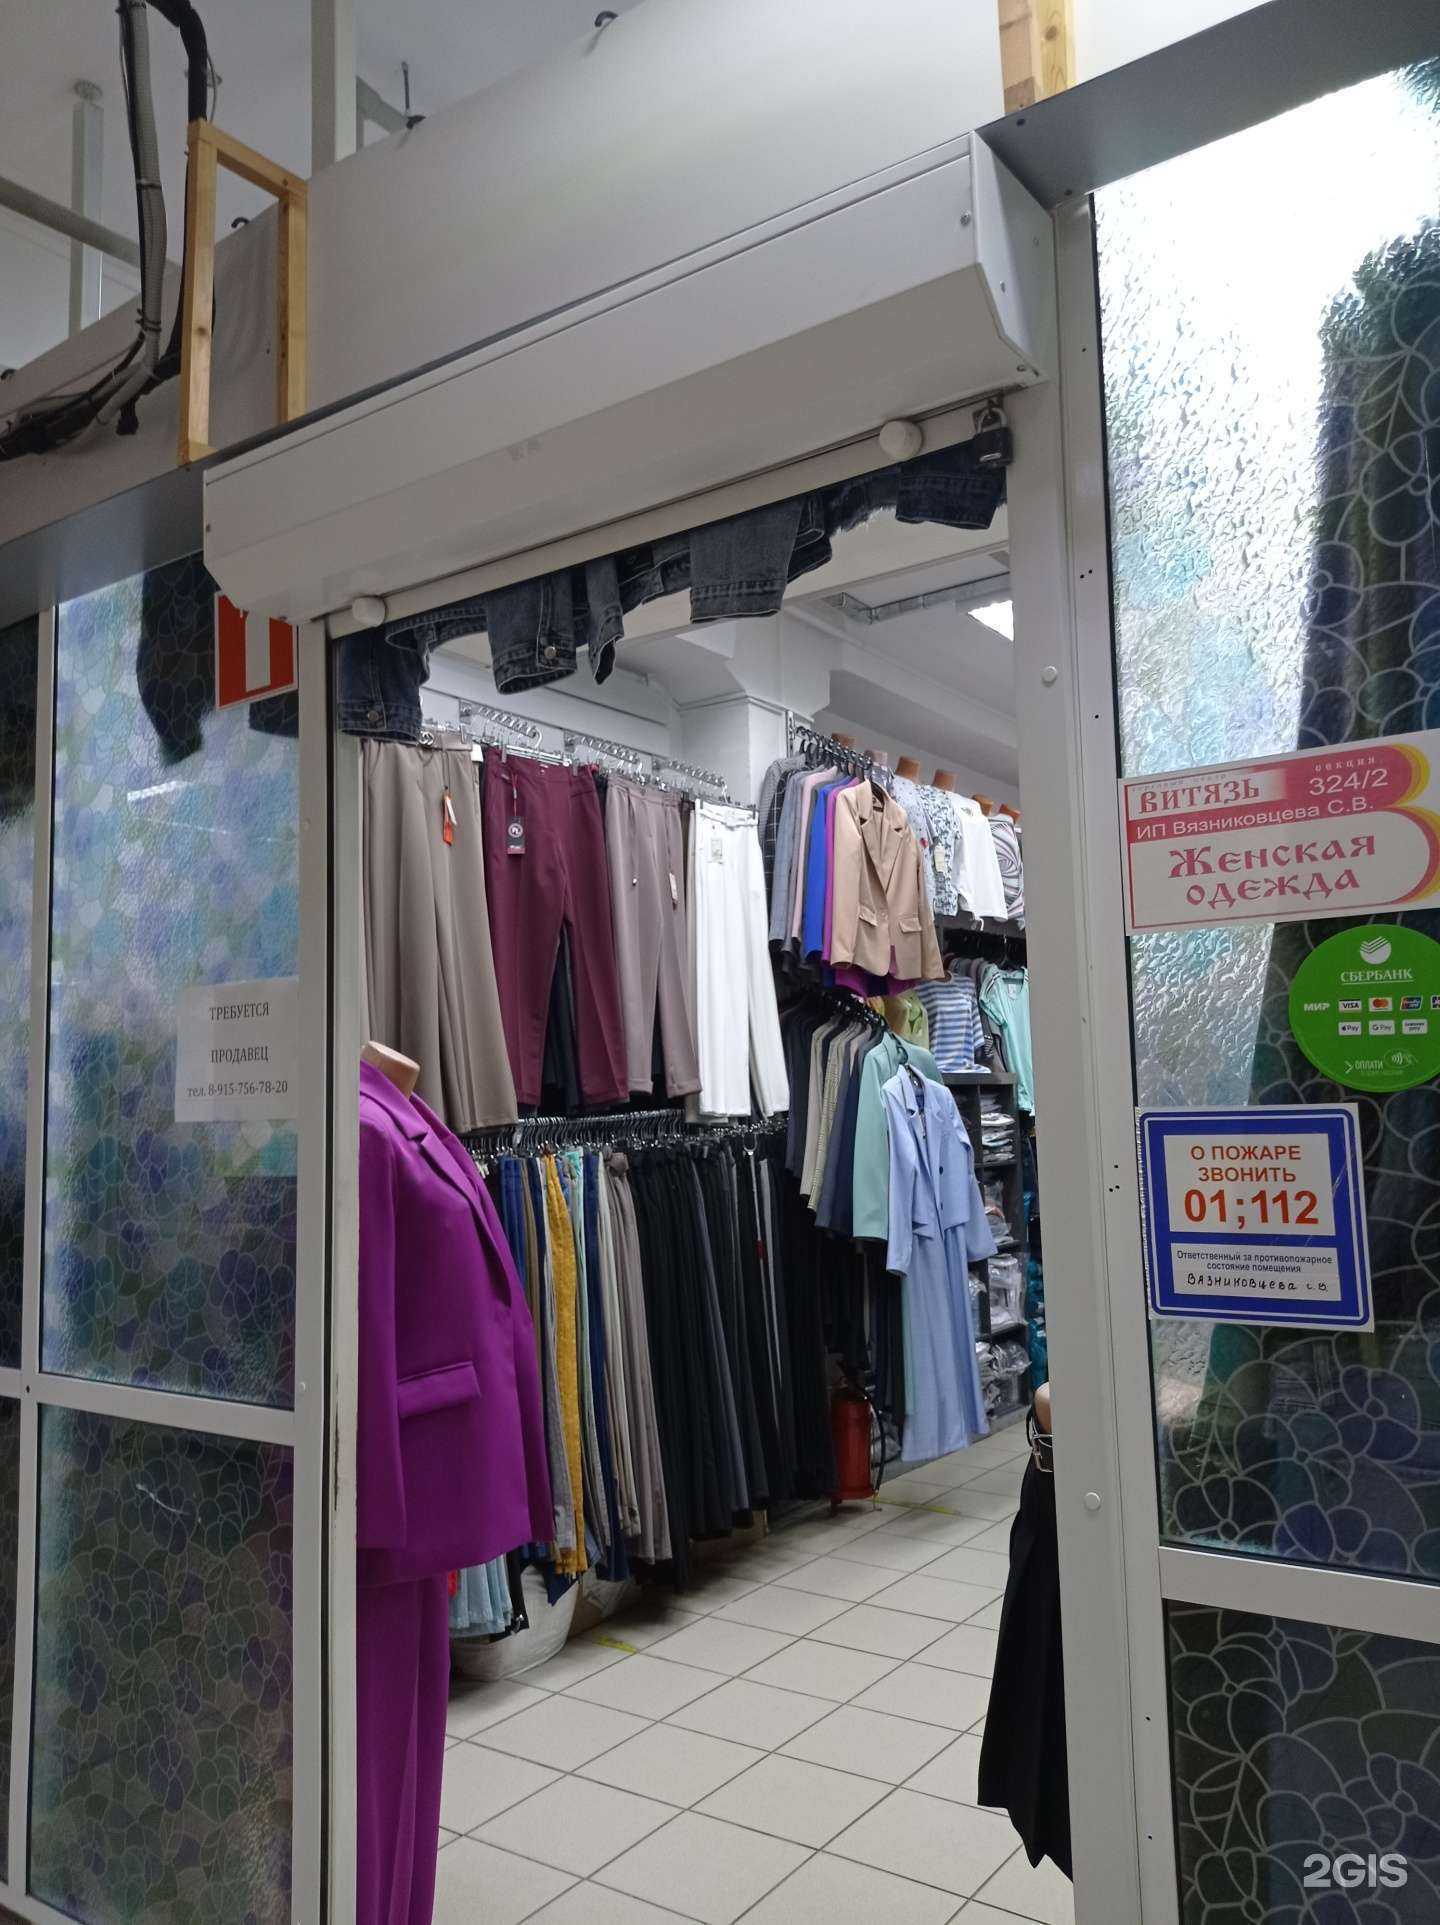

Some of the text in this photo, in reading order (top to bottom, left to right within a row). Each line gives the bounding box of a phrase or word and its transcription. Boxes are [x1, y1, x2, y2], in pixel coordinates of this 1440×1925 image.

[1309, 768, 1388, 796] 324/2
[1138, 779, 1260, 814] ВИТЯЗЬ
[1136, 797, 1374, 840] ИП Вязниковцева С.В.
[1340, 968, 1413, 982] СБЕРБАНК
[209, 1002, 269, 1020] ТРЕБУЕТСЯ
[211, 1046, 269, 1063] ПРОДАВЕЦ
[1190, 1145, 1302, 1161] О ПОЖАРЕ
[1198, 1167, 1297, 1182] ЗВОНИТЬ
[1184, 1189, 1319, 1229] 01;112
[1177, 1250, 1332, 1265] Ответственный за противопожарное
[1207, 1262, 1301, 1274] состояние помещения
